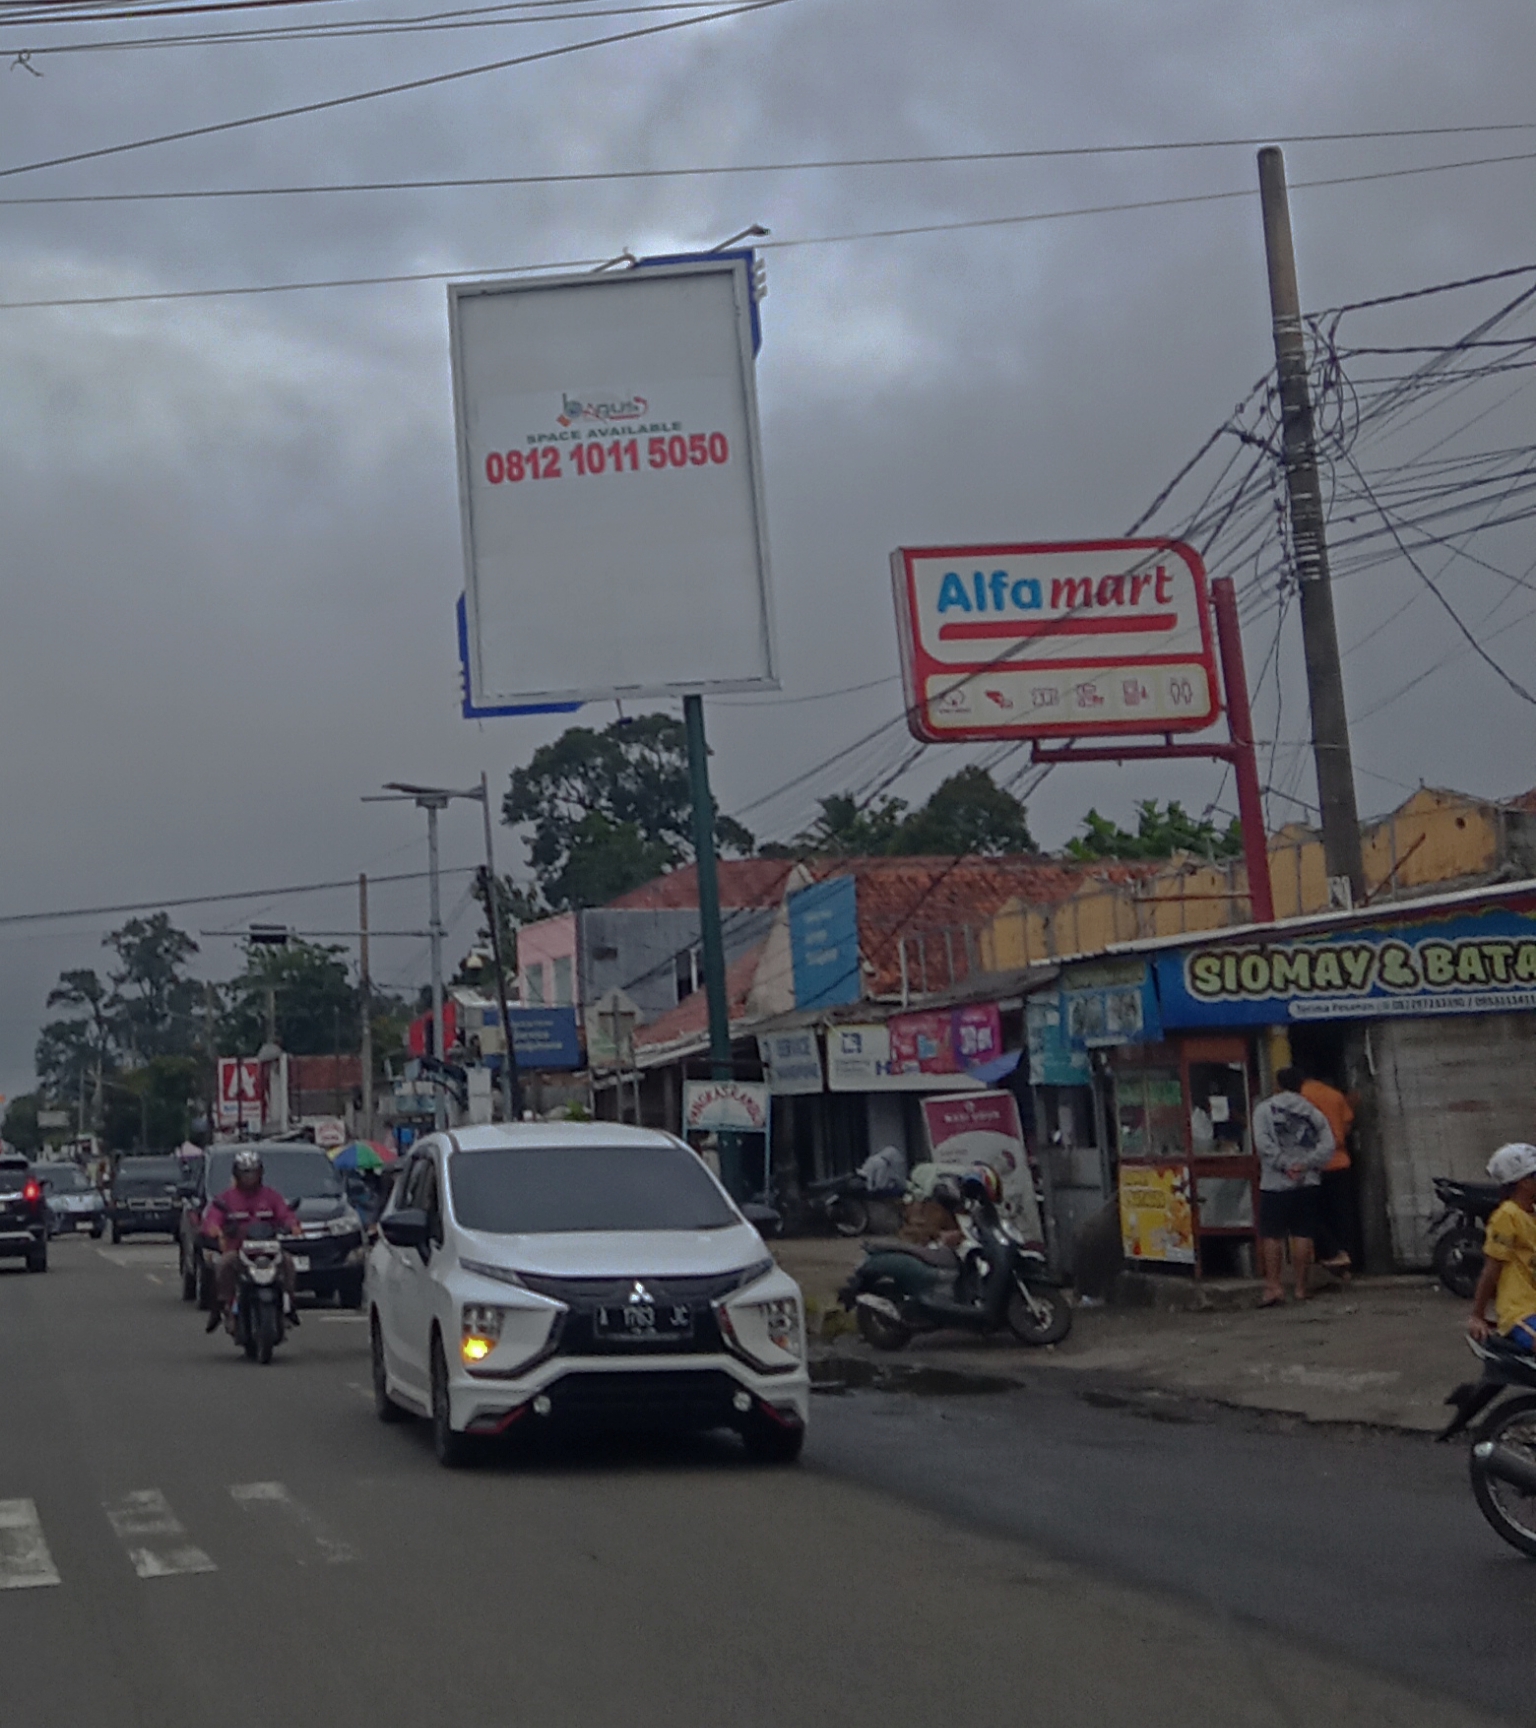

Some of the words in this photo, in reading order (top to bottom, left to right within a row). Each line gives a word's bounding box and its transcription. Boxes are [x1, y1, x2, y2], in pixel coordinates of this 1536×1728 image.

[485, 446, 562, 484] 0812
[569, 438, 640, 476] 1011
[647, 431, 729, 469] 5050
[526, 430, 582, 445] SPACE
[587, 421, 683, 440] AVAILABLE
[936, 565, 1175, 614] Alfamart
[1191, 946, 1373, 995] SIOMAY
[1378, 943, 1420, 987] &
[1422, 942, 1536, 985] BATA
